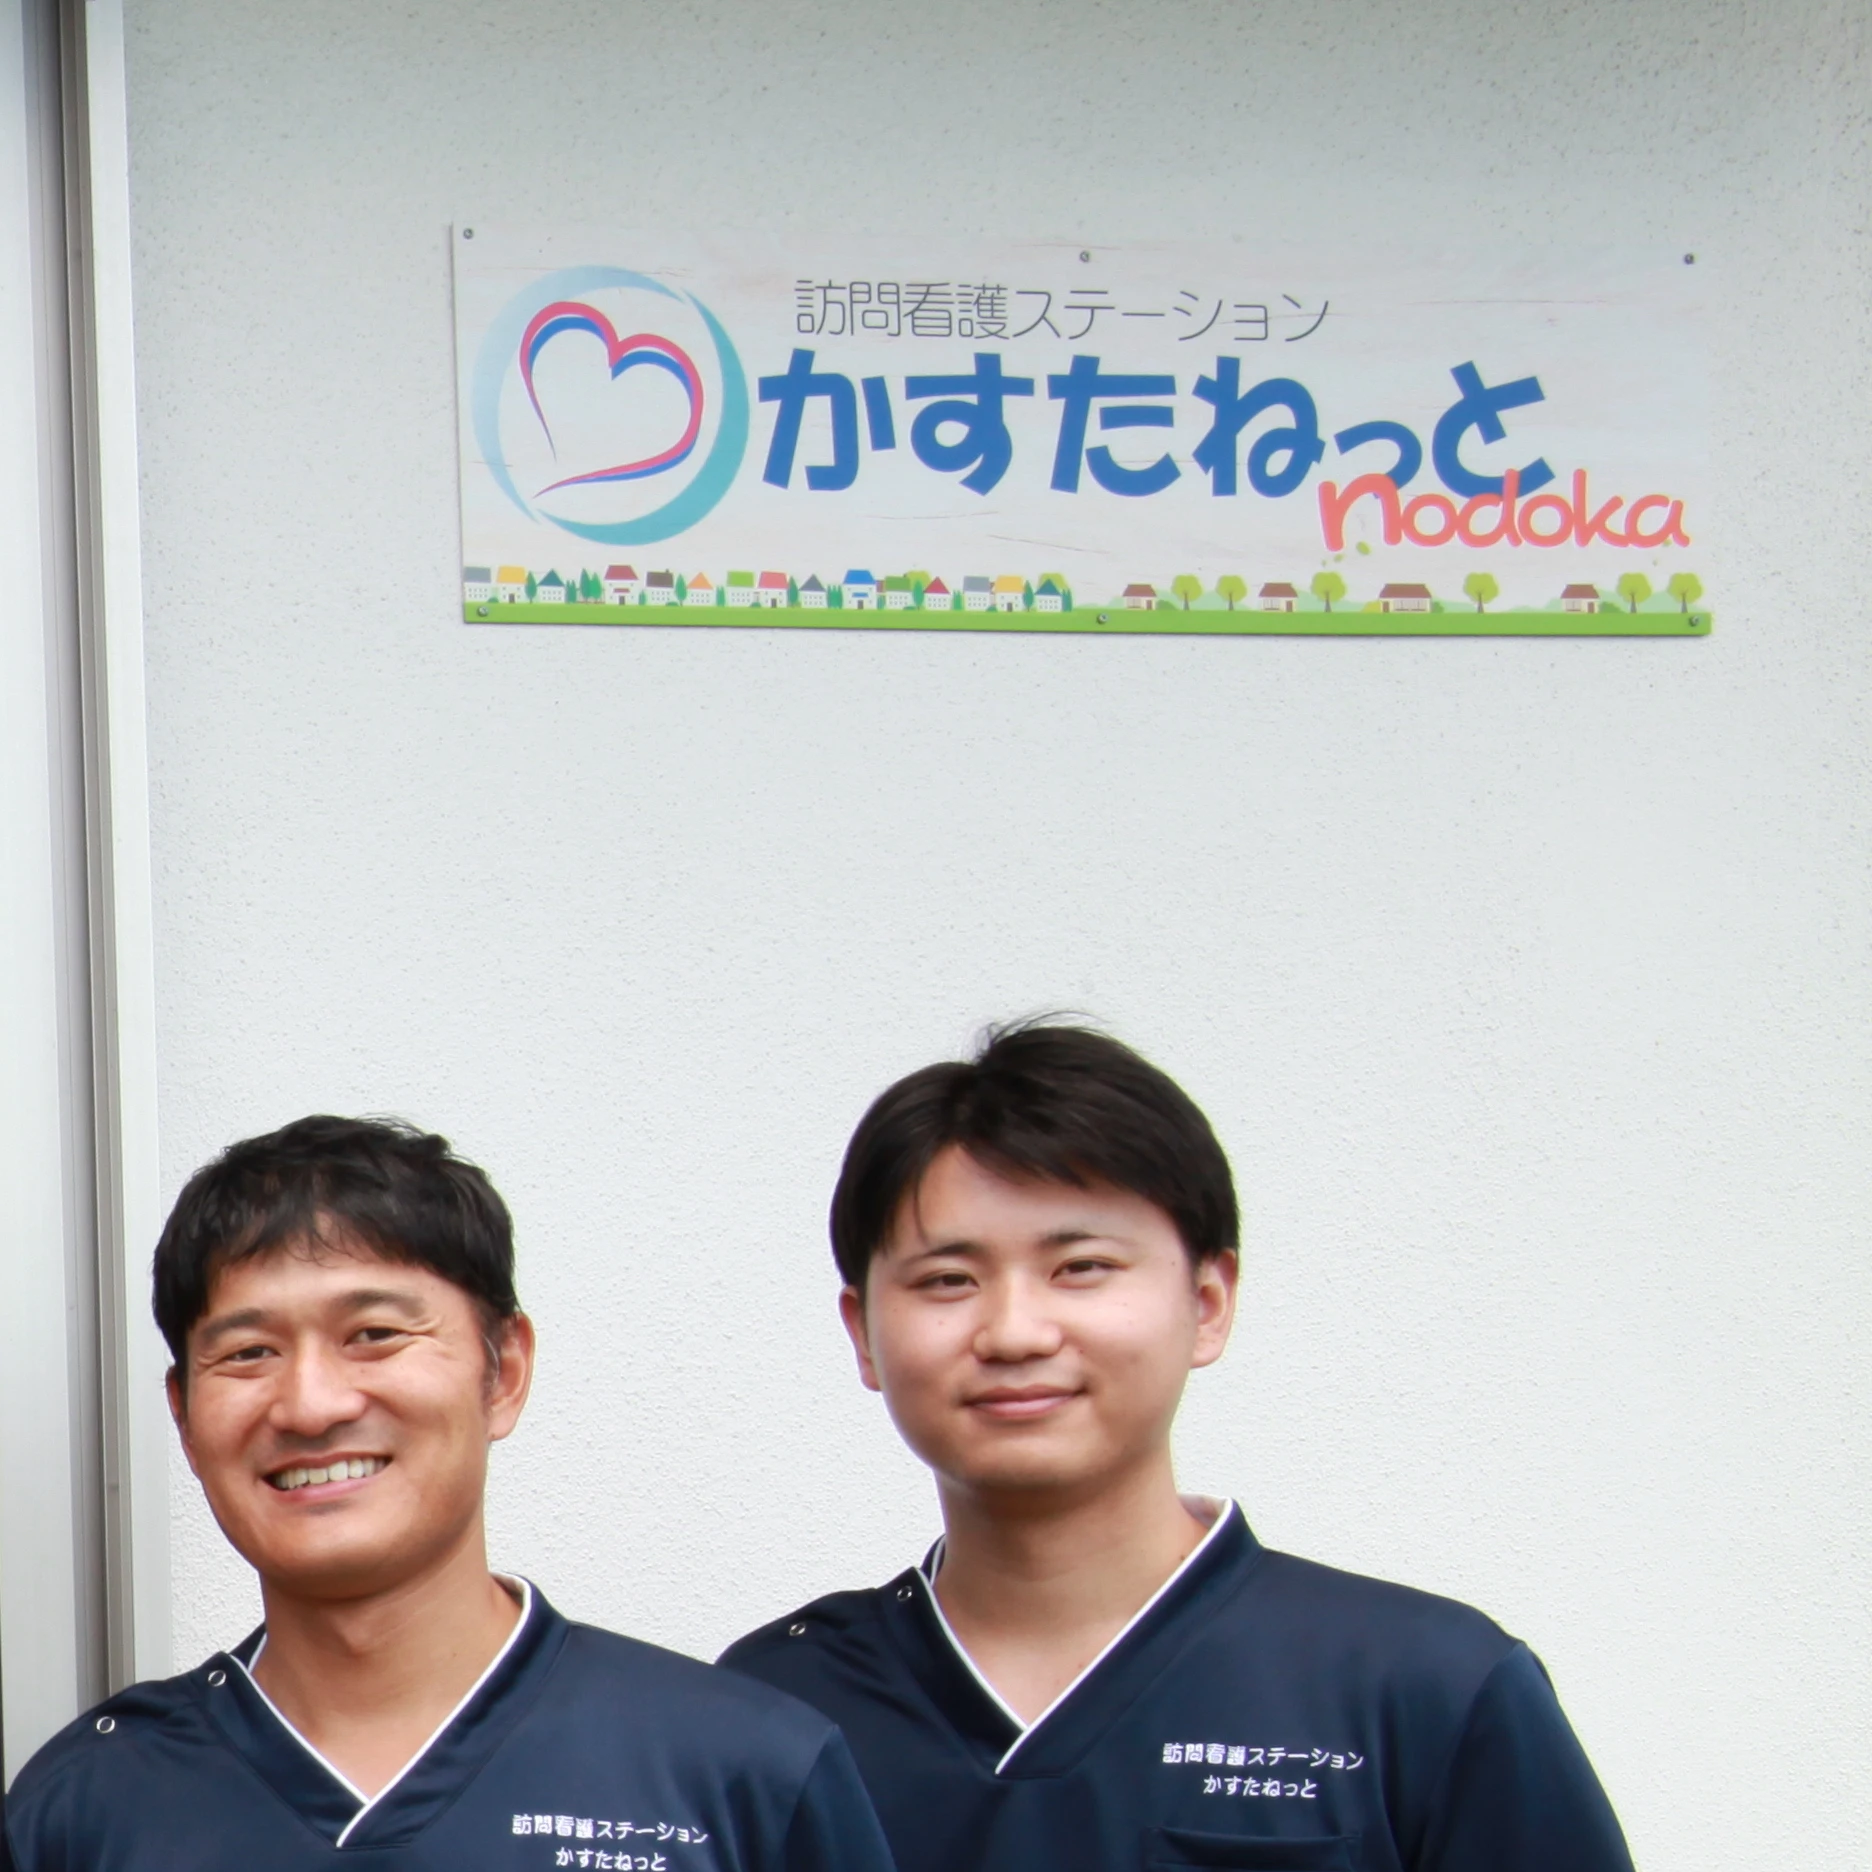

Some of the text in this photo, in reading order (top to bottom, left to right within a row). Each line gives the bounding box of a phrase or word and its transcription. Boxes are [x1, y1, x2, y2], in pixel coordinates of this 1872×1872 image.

[794, 278, 1329, 341] 訪問看護ステーション
[758, 348, 1556, 497] かすたねっと
[1318, 468, 1691, 551] nodoka
[1160, 1743, 1364, 1770] 訪問看護ステーション
[1203, 1775, 1317, 1798] かすたねっと
[512, 1814, 708, 1843] 訪問看護ステーション
[556, 1847, 667, 1871] かすたねっと
